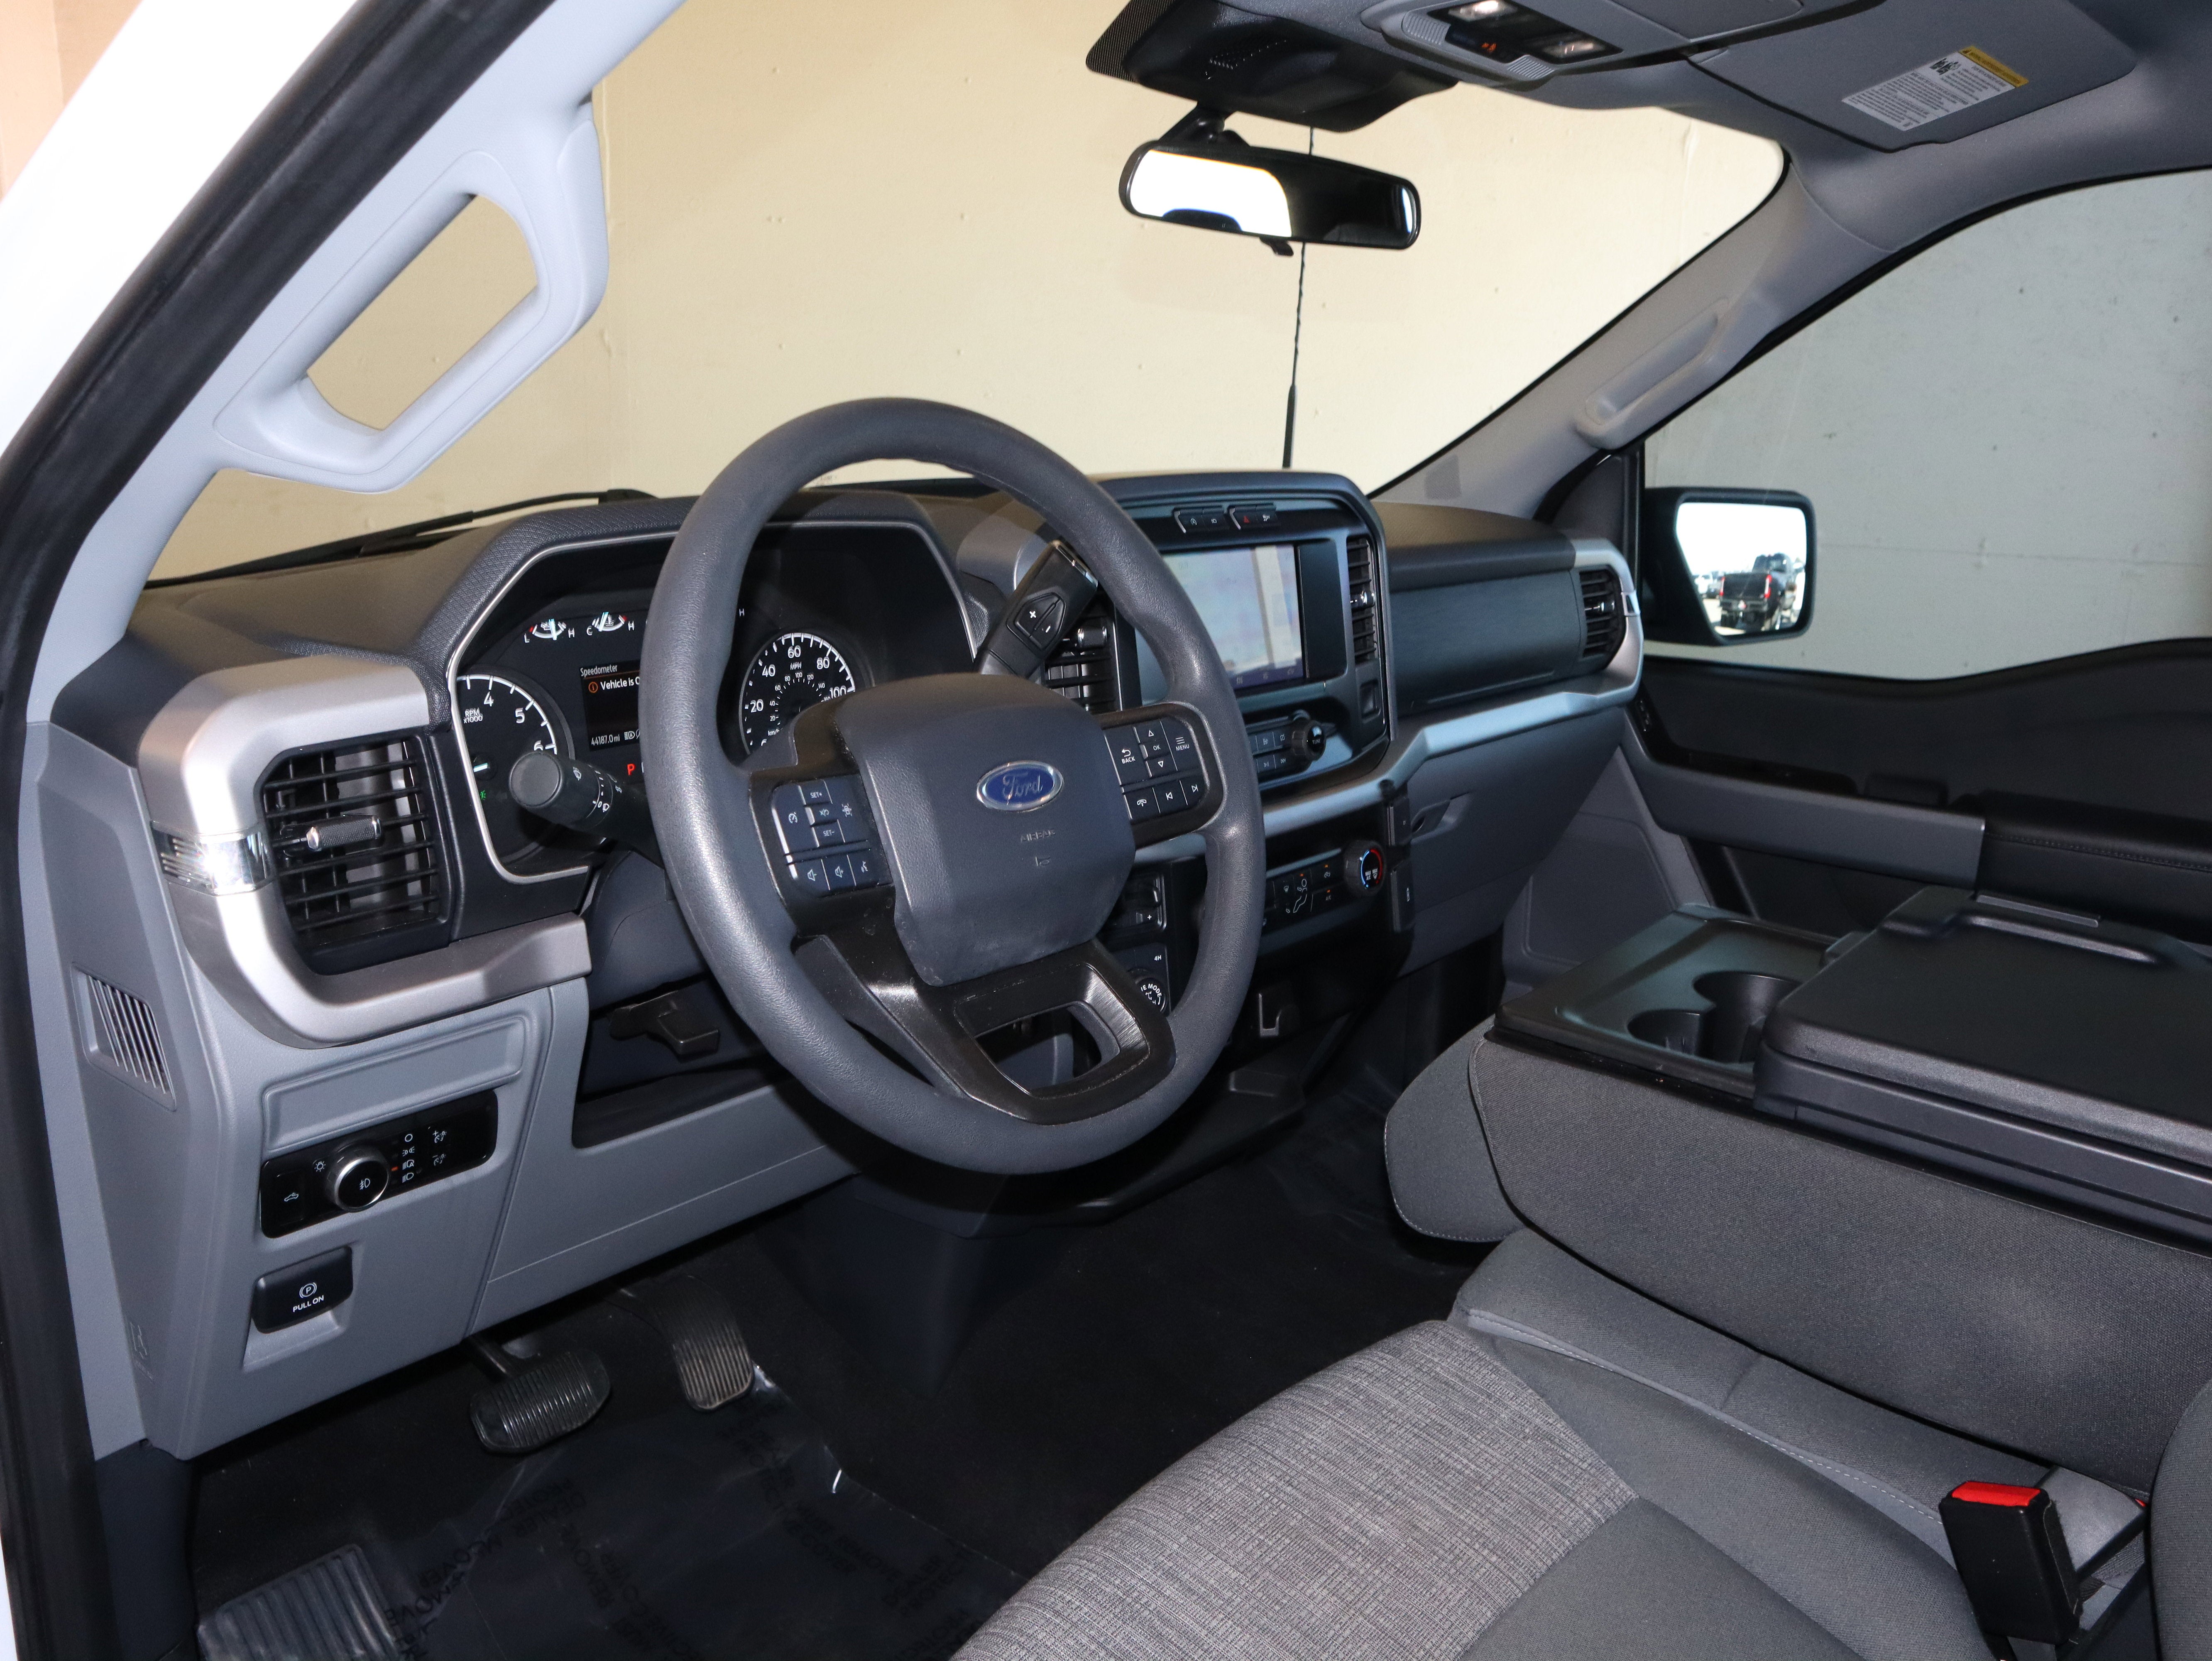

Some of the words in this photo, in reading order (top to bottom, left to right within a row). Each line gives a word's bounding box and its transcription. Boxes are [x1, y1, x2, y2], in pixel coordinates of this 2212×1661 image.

[586, 627, 593, 636] C
[628, 621, 635, 631] H
[524, 633, 530, 643] L
[568, 628, 575, 638] H
[788, 645, 801, 658] 60
[790, 661, 802, 670] MPH
[817, 656, 830, 670] 80
[580, 664, 617, 678] Speedometer
[762, 664, 776, 677] 40
[600, 679, 628, 690] Vehicle
[628, 677, 634, 686] is
[830, 685, 847, 699] 100
[483, 691, 494, 707] 4
[465, 708, 481, 717] RPM
[750, 699, 764, 713] 20
[515, 707, 525, 723] 5
[627, 763, 636, 776] P
[1002, 771, 1043, 805] Ford
[1148, 983, 1162, 997] MODE
[293, 1301, 312, 1313] PULL
[312, 1295, 324, 1304] ON
